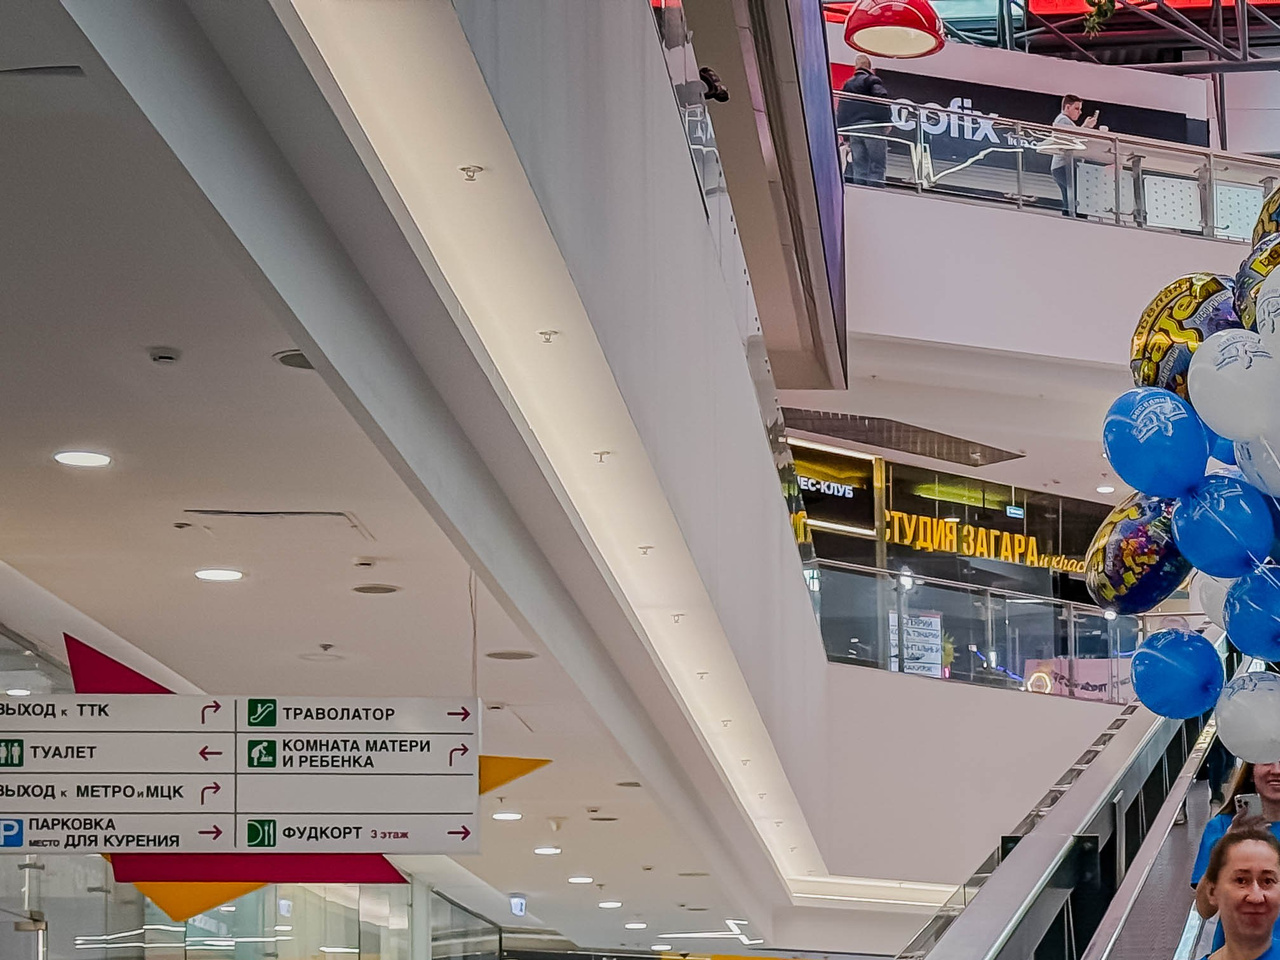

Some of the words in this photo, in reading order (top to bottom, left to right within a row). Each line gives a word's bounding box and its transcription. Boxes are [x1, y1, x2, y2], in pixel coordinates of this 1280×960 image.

[797, 475, 854, 498] ЕС-КЛУБ
[963, 525, 1039, 568] ЗАГАРА
[77, 703, 109, 717] ТТК
[283, 707, 395, 721] ТРАВОЛАТОР
[30, 746, 97, 759] ТУАЛЕТ
[283, 739, 358, 752] КОМНАТА
[366, 740, 430, 753] МАТЕРИ
[283, 756, 293, 768] И
[299, 755, 374, 768] РЕБЕНКА
[29, 818, 116, 831] ПАРКОВКА
[282, 826, 363, 841] ФУДКОРТ
[370, 830, 378, 839] 3
[380, 831, 409, 839] этаж
[29, 839, 60, 848] МЕСТО
[64, 835, 98, 848] ДЛЯ
[103, 835, 180, 847] КУРЕНИЯ
